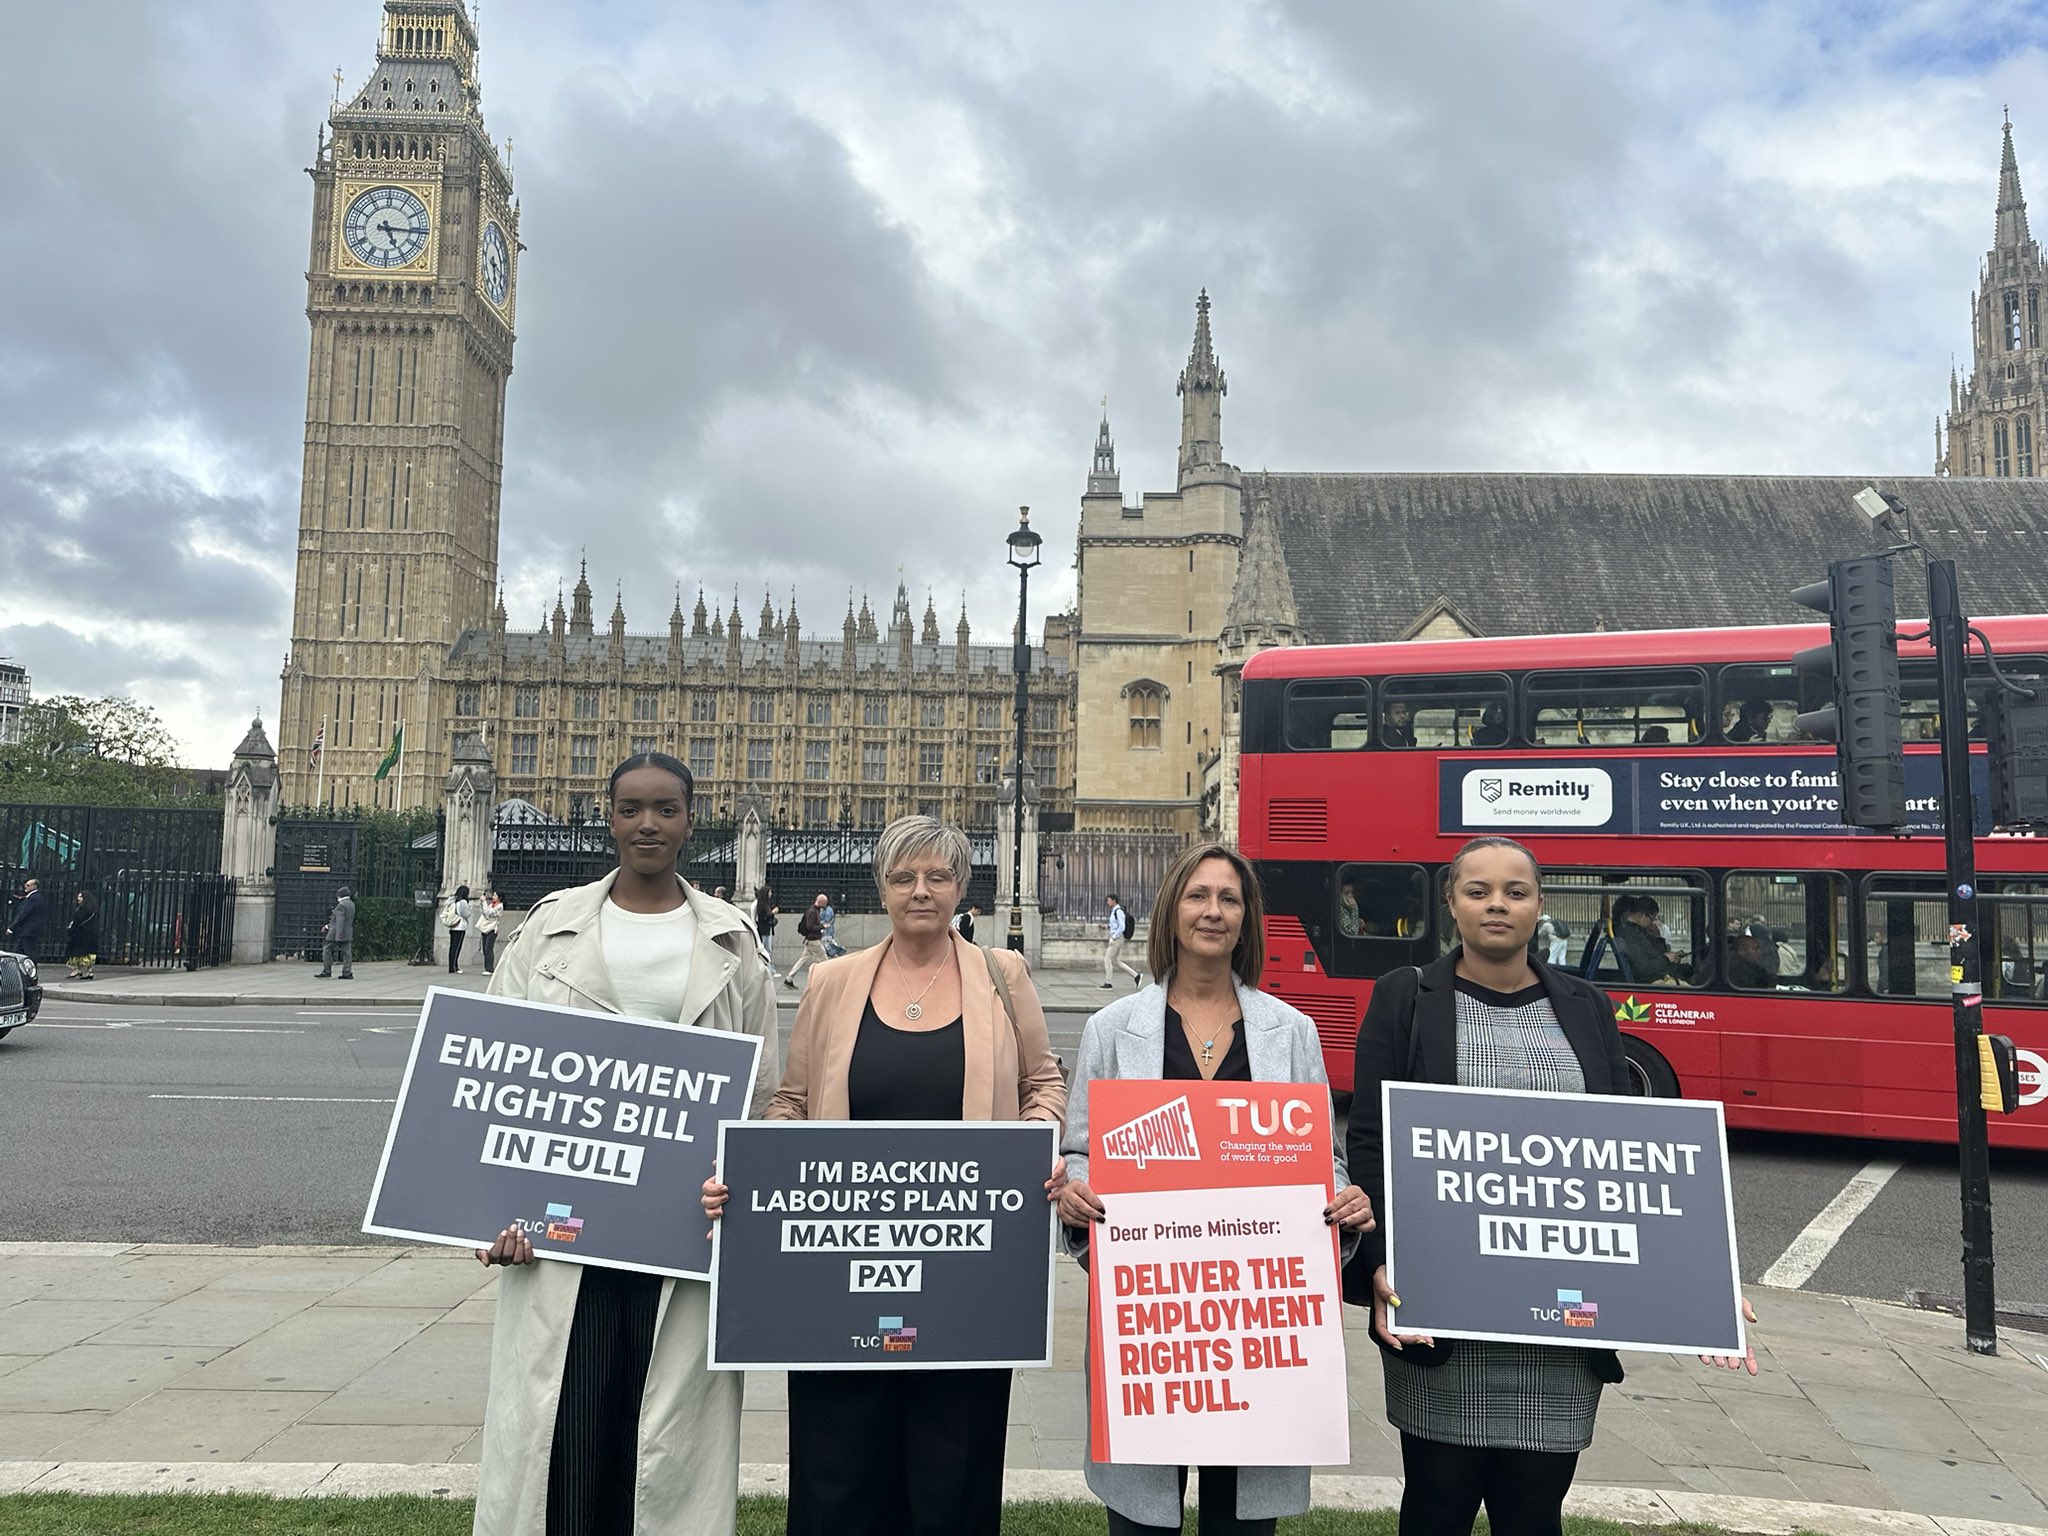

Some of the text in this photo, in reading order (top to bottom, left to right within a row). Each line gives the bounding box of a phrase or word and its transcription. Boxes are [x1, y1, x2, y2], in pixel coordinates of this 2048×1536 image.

[1508, 779, 1590, 801] Remitly
[1660, 769, 1840, 792] Stay close to fami
[1493, 807, 1581, 817] Send money worldwide
[1660, 793, 1940, 815] even when you're art.
[1750, 822, 1777, 830] regulated
[1655, 1009, 1715, 1020] CLEANERAIR
[1669, 1018, 1696, 1026] LONDON
[439, 1033, 731, 1105] EMPLOYMENT
[2020, 1074, 2036, 1082] SES
[451, 1077, 695, 1143] RIGHTS BILL
[1216, 1098, 1314, 1137] TUC
[1105, 1102, 1197, 1167] MEGAPHONE
[491, 1131, 633, 1179] IN FULL
[1220, 1141, 1313, 1152] Changing the world
[1220, 1152, 1298, 1164] of work for good
[1411, 1127, 1701, 1175] EMPLOYMENT
[800, 1161, 980, 1183] I'M BACKING
[752, 1189, 1024, 1212] LABOUR'S PLAN TO
[1437, 1170, 1683, 1216] RIGHTS BILL
[515, 1218, 545, 1234] TUC
[789, 1223, 986, 1247] MAKE WORK
[1110, 1218, 1281, 1242] Dear Prime Minister:
[1489, 1221, 1631, 1258] IN FULL
[858, 1265, 916, 1288] PAY
[1114, 1256, 1307, 1297] DELIVER THE
[1117, 1294, 1325, 1336] EMPLOYMENT
[1530, 1307, 1561, 1322] TUC
[850, 1336, 880, 1348] TUC
[1120, 1335, 1308, 1376] RIGHTS BILL
[1122, 1378, 1250, 1416] IN FULL.
